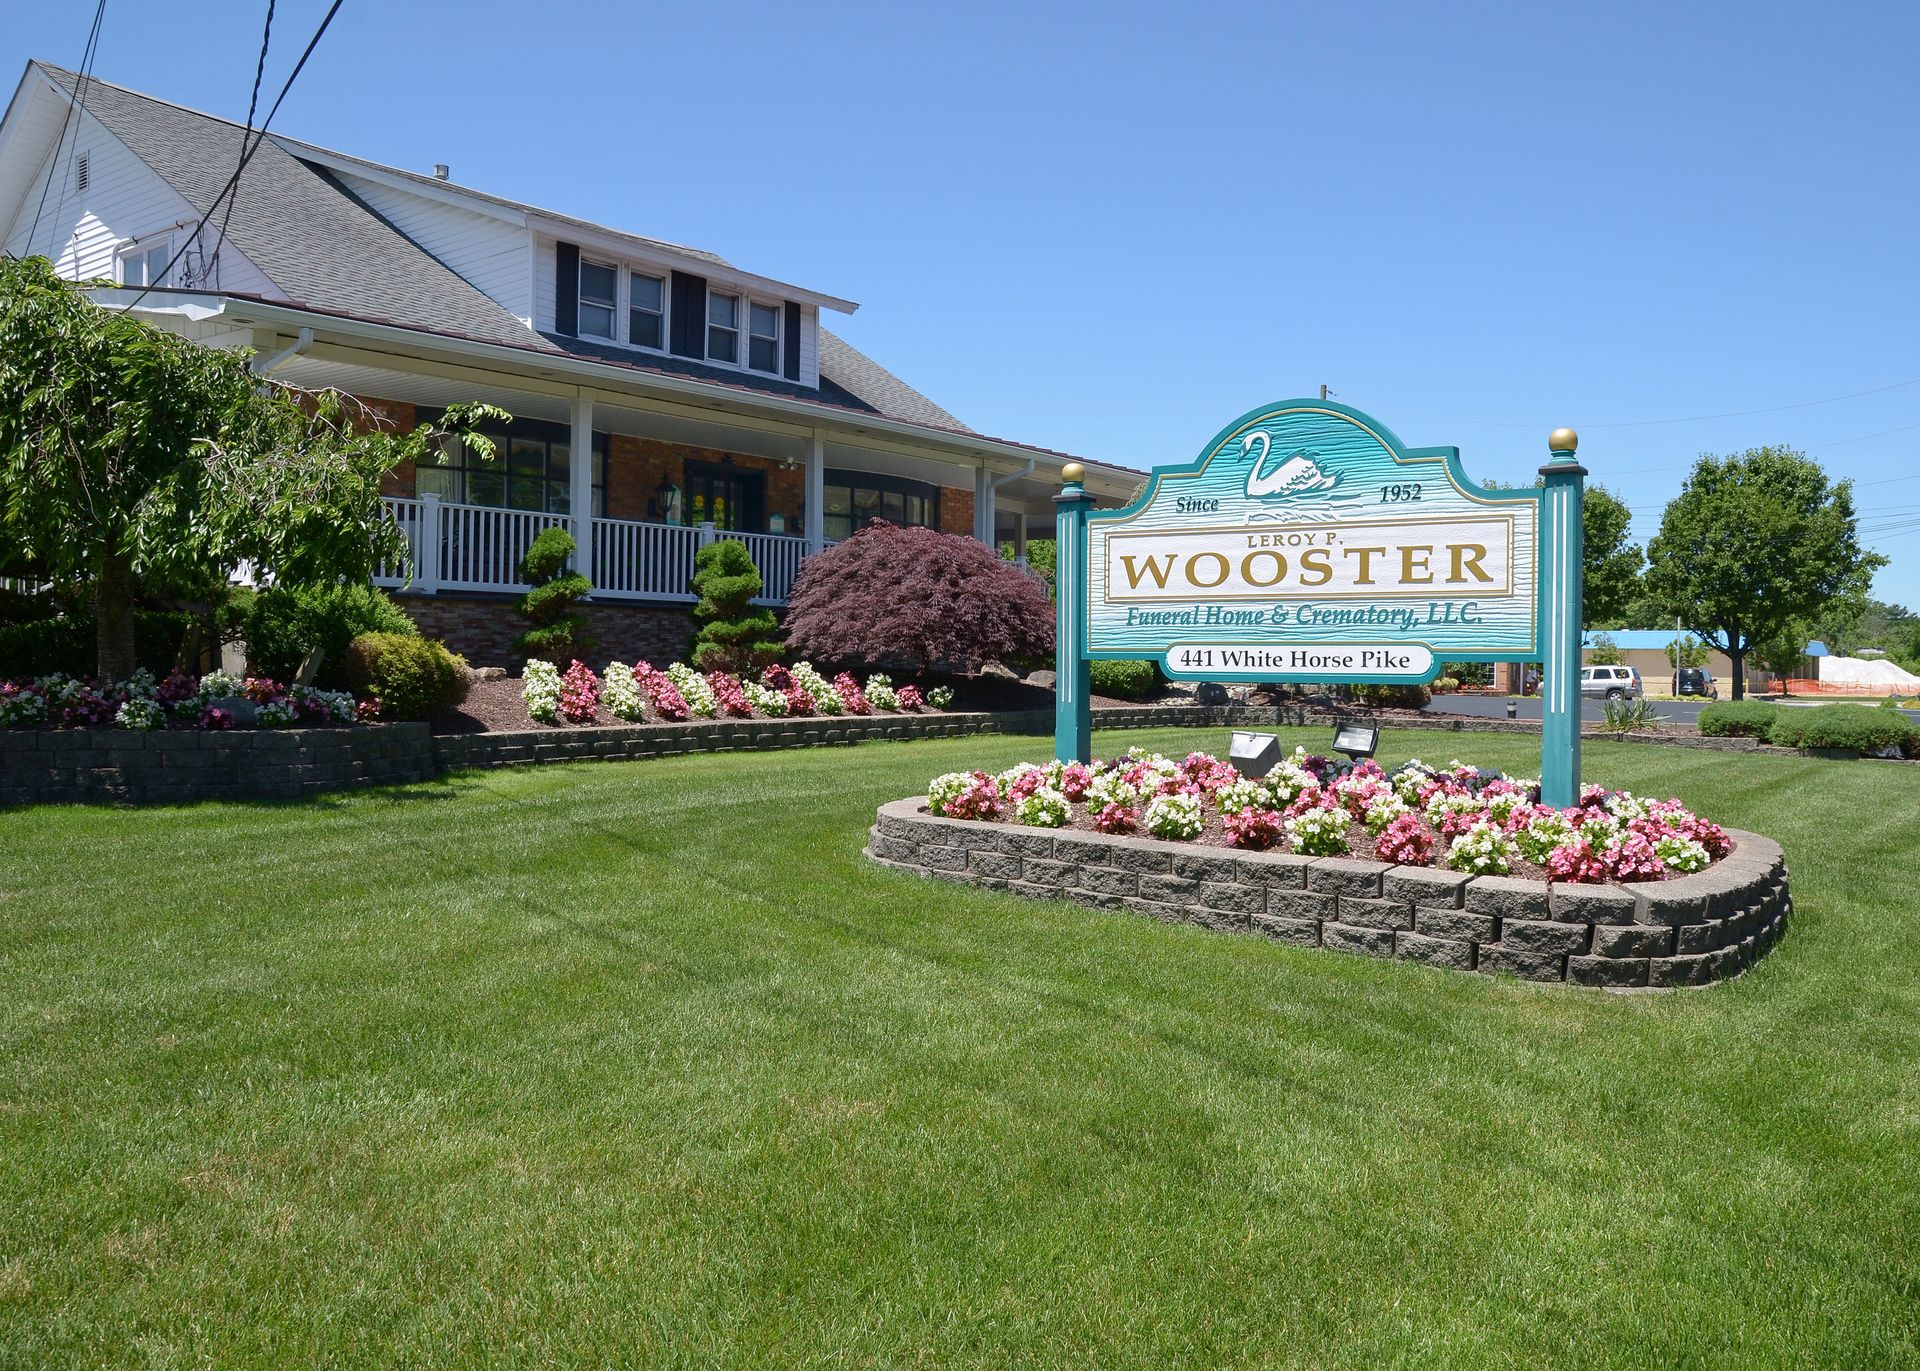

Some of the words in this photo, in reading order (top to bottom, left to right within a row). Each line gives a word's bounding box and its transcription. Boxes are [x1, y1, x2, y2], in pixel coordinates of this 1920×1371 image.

[1175, 496, 1220, 513] Since
[1380, 483, 1422, 503] 1952
[1247, 533, 1316, 548] LEROY
[1326, 532, 1343, 545] P.
[1119, 543, 1494, 590] WOOSTER
[1126, 605, 1200, 626] Funeral
[1204, 605, 1264, 626] Home
[1271, 604, 1290, 625] &
[1296, 604, 1420, 632] Crematory,
[1427, 602, 1482, 625] LLC.
[1180, 649, 1214, 667] 441
[1221, 650, 1283, 668] White
[1289, 650, 1353, 668] Horse
[1360, 650, 1410, 668] Pike
